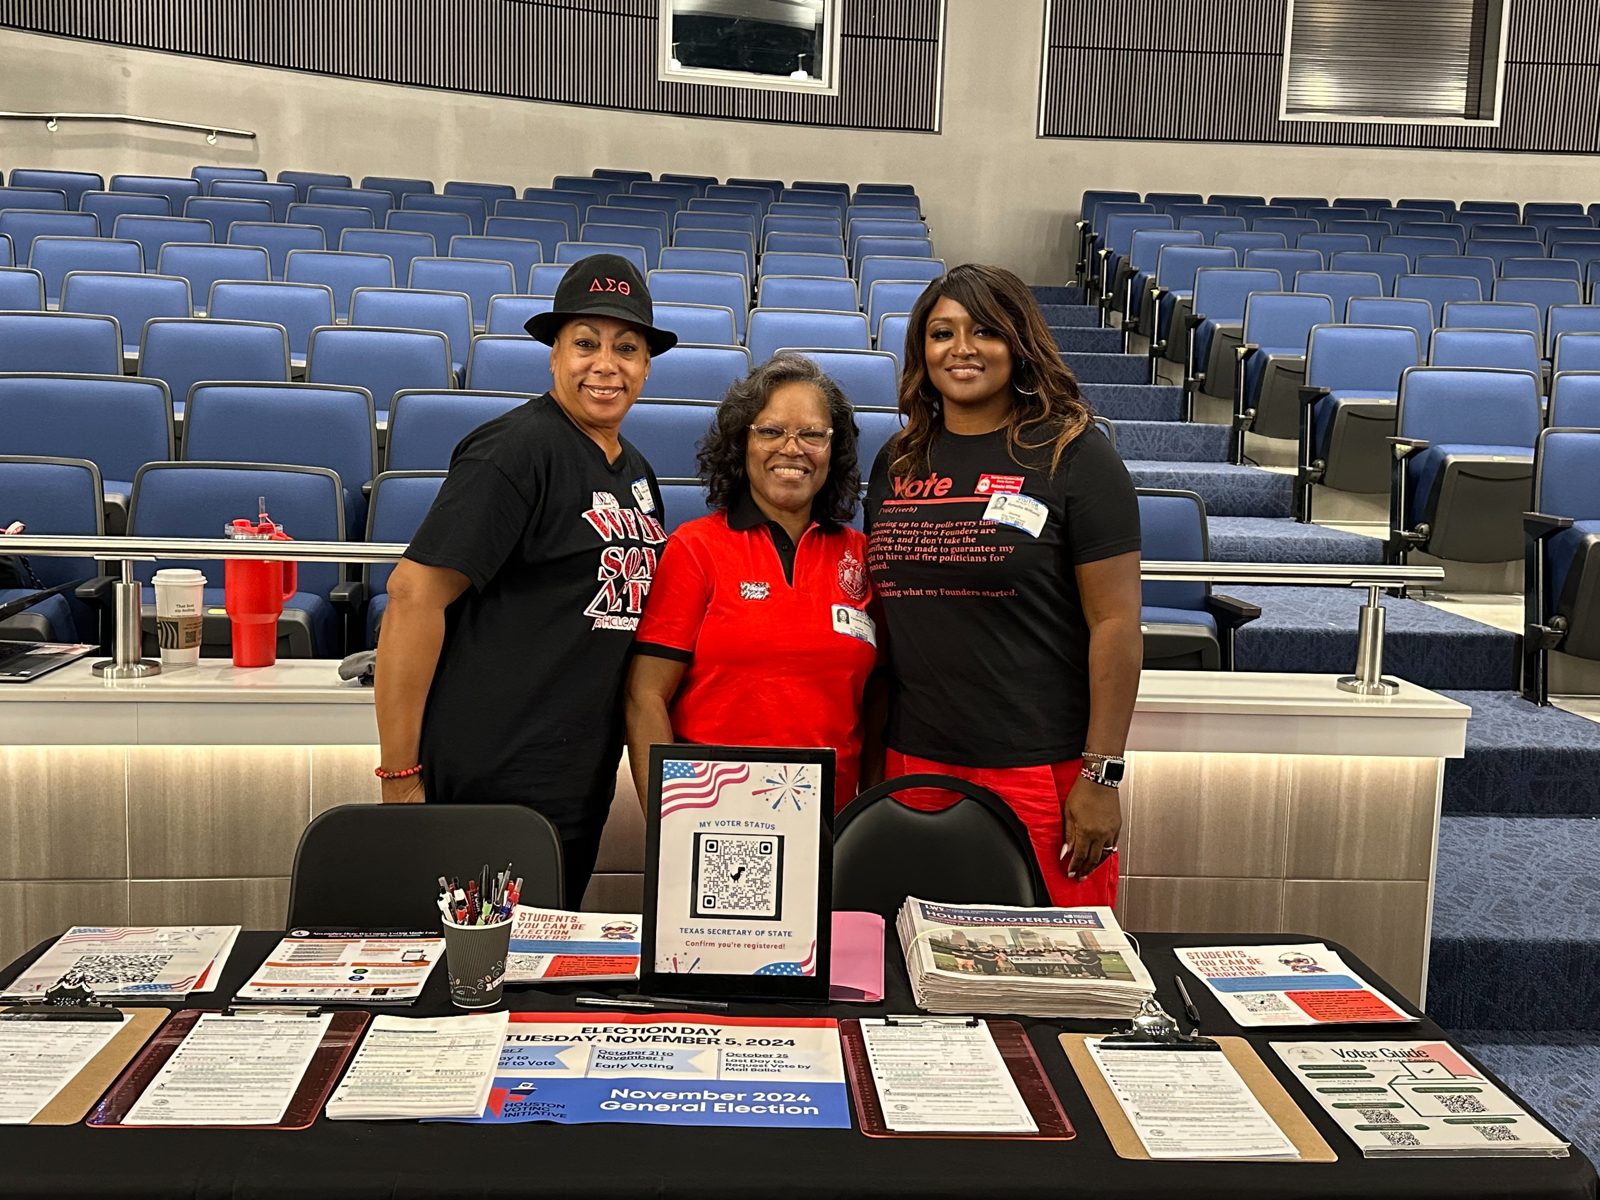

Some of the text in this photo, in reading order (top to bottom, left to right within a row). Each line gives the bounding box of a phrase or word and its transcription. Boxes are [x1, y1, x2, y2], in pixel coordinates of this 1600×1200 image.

[589, 278, 630, 296] ΔΣΘ
[935, 521, 954, 530] polls
[955, 520, 977, 530] every
[940, 528, 978, 536] Founders
[894, 544, 912, 553] they
[950, 545, 996, 554] guarantee
[939, 554, 987, 563] politicians
[982, 589, 1018, 597] started.
[744, 820, 776, 830] STATUS
[926, 910, 996, 922] HOUSTON
[707, 928, 752, 936] SECRETARY
[718, 941, 740, 949] you're
[744, 942, 786, 950] registered!
[581, 1026, 722, 1036] ELECTION DAY
[606, 1035, 721, 1045] NOVEMBER
[725, 1038, 742, 1046] 5,
[1330, 1048, 1378, 1058] Voter
[1379, 1048, 1430, 1058] Guide
[610, 1089, 812, 1102] November 2024
[600, 1100, 819, 1115] General Election
